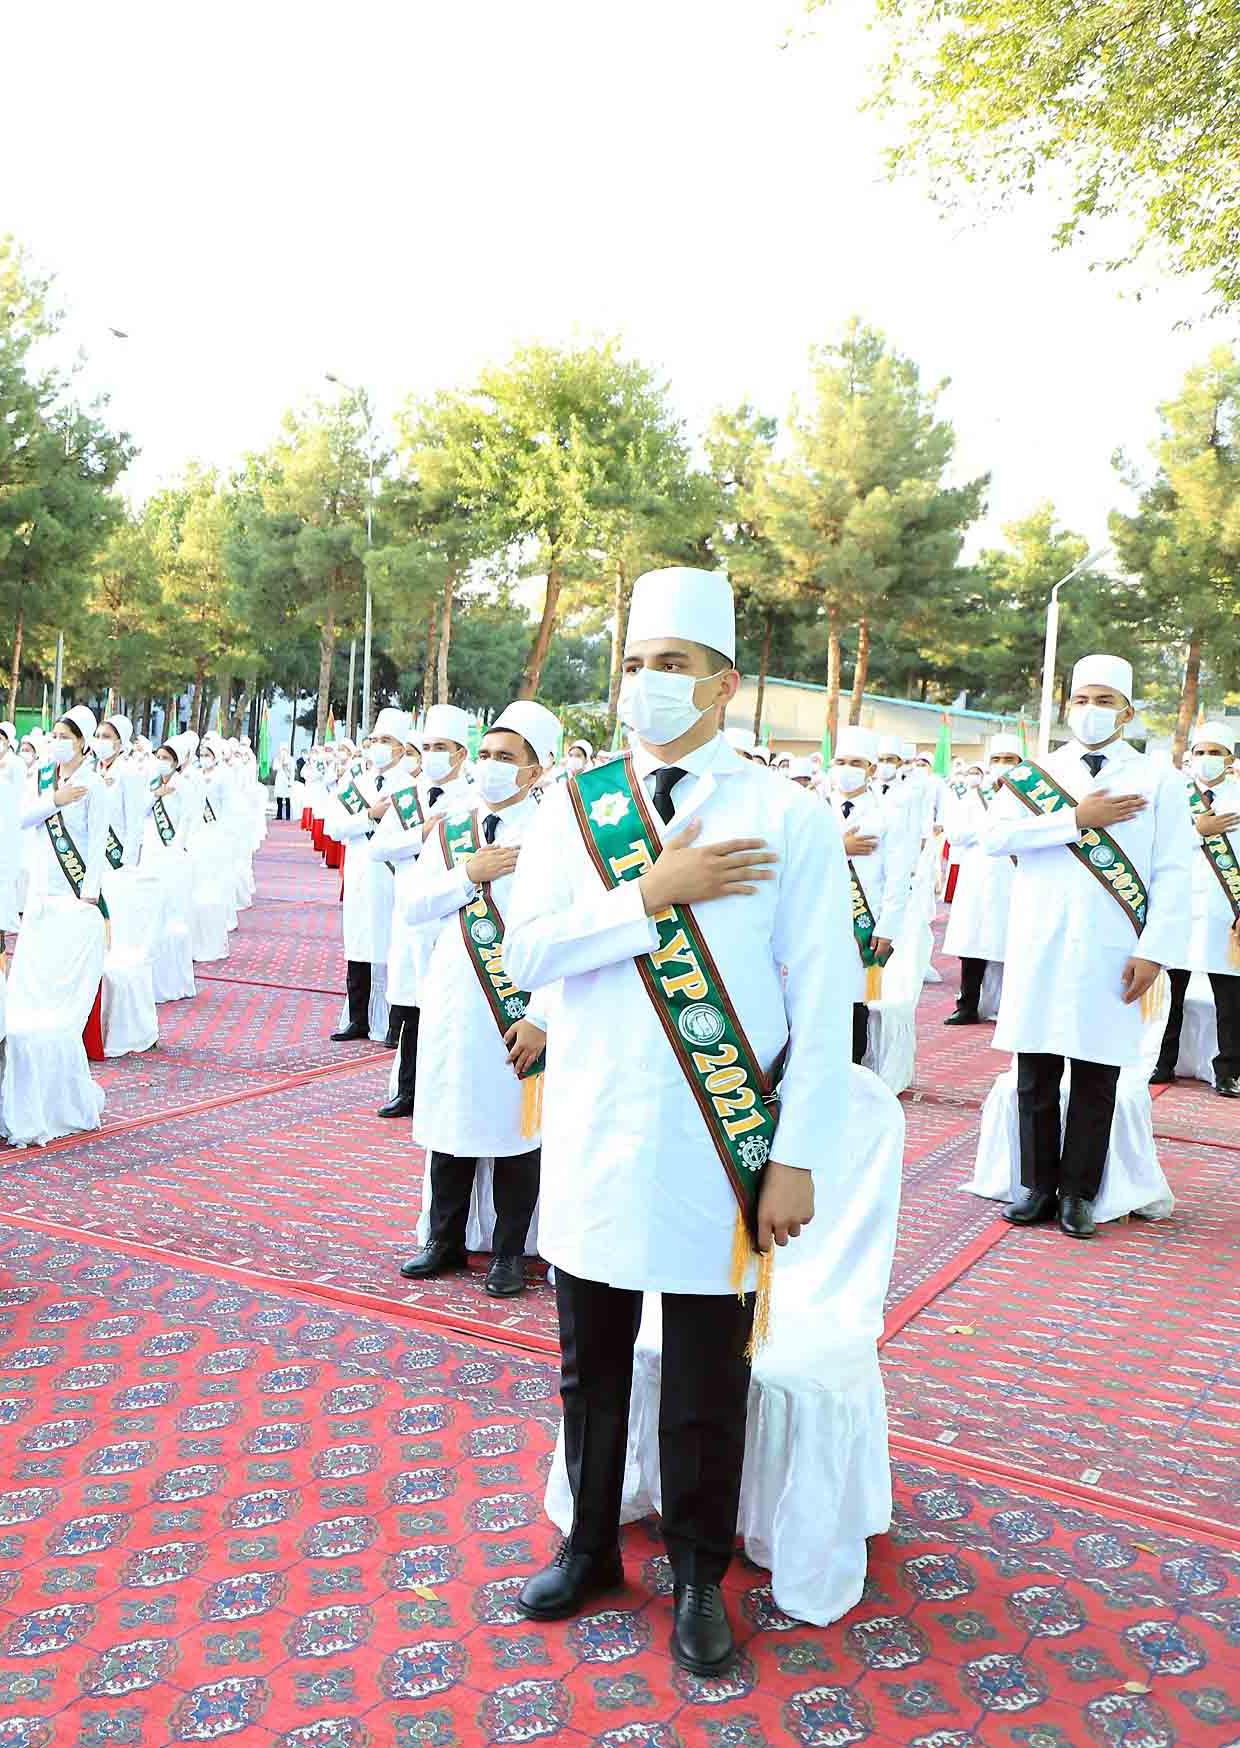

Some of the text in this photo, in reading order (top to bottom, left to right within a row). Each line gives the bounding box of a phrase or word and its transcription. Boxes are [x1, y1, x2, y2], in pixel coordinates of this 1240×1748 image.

[60, 850, 85, 882] 2021
[1102, 862, 1145, 910] 2021
[478, 942, 521, 1001] 2021
[692, 1043, 766, 1141] 2021
